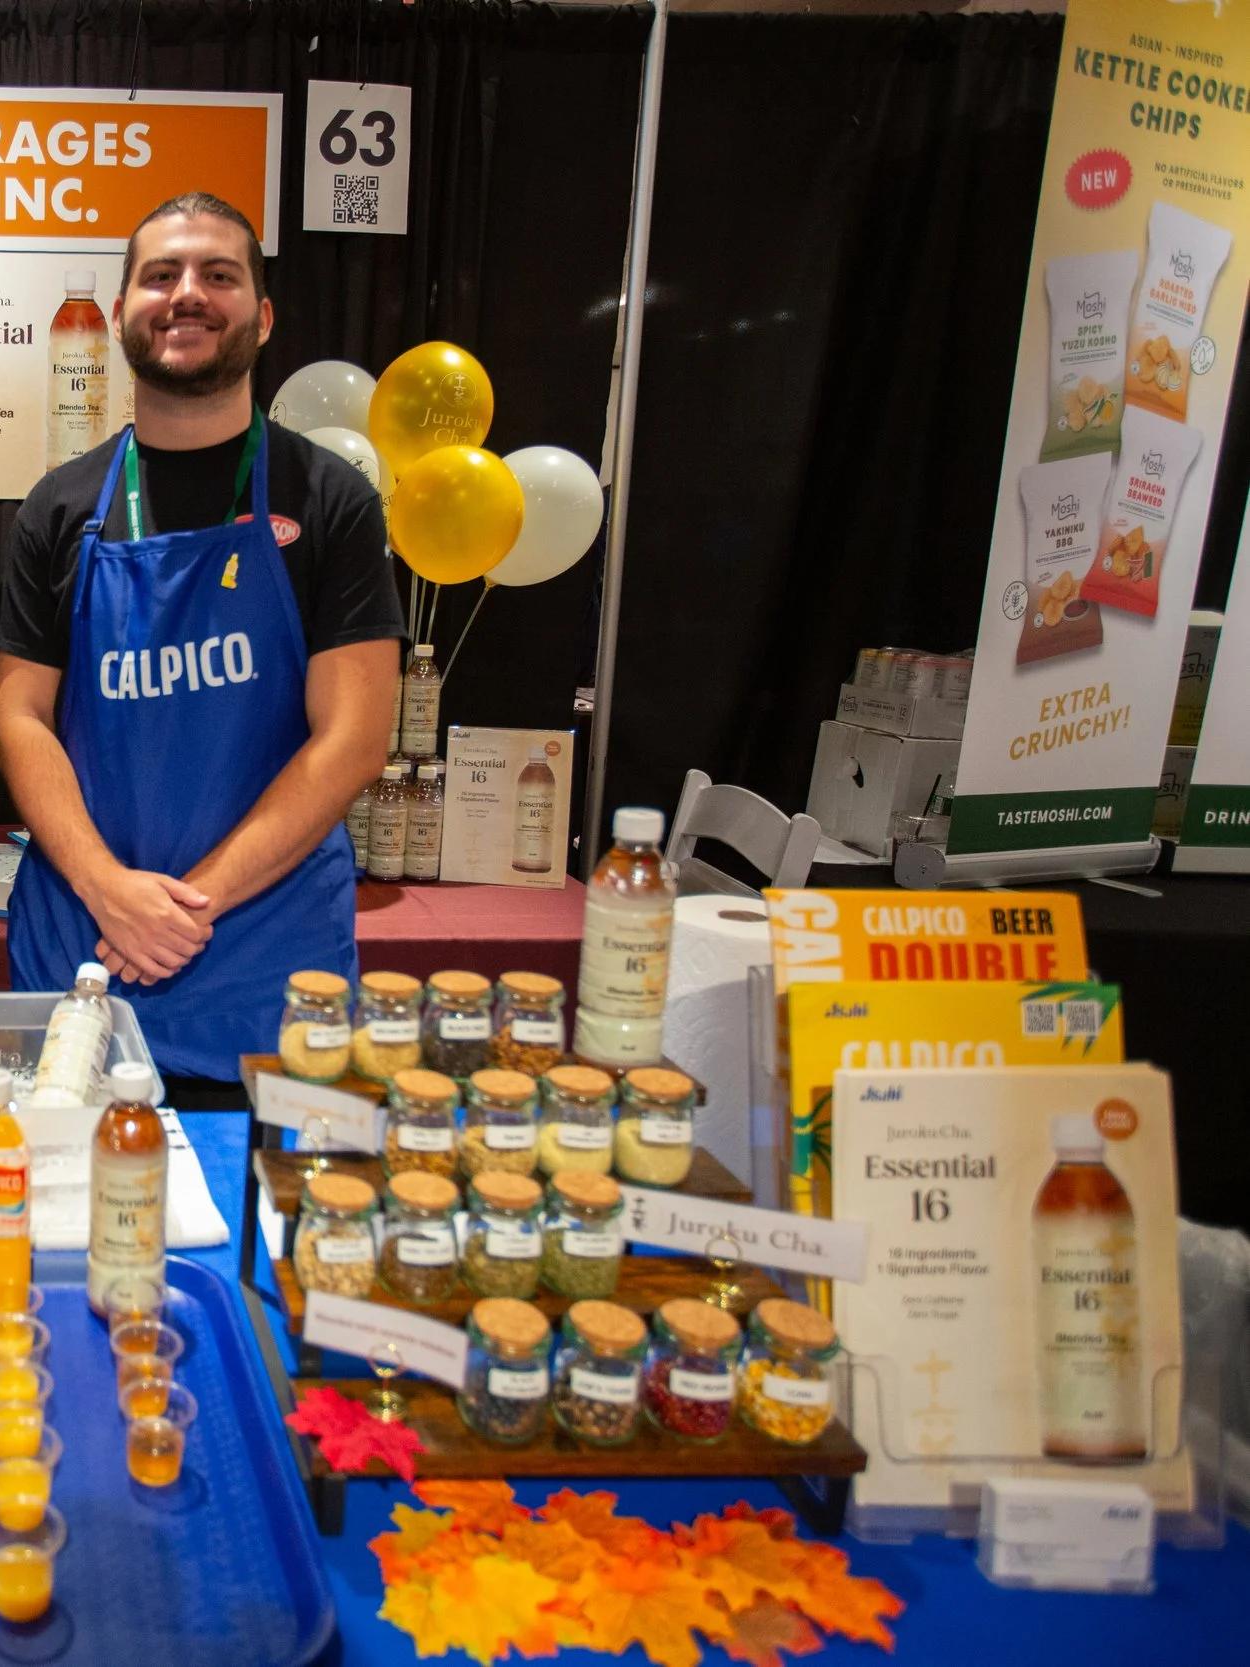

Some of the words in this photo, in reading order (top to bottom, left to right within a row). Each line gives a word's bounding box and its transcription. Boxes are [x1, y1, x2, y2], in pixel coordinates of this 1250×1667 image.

[1130, 34, 1162, 53] ASIAN
[1175, 46, 1223, 68] INSPIRED
[1074, 47, 1161, 92] KETTLE
[1130, 102, 1201, 139] CHIPS
[319, 109, 396, 167] 63
[1081, 168, 1117, 192] NEW
[1155, 162, 1167, 173] NO
[1169, 164, 1209, 182] ARTIFICIAL
[1210, 176, 1245, 190] FLAVORS
[1163, 177, 1174, 187] OR
[1175, 180, 1232, 200] PRESERVATIVES
[1170, 252, 1195, 279] Moshi
[1159, 279, 1194, 300] ROASTED
[1076, 295, 1106, 317] Moshi
[1077, 325, 1103, 336] SPICY
[1061, 339, 1085, 351] YUZU
[1088, 335, 1117, 348] KOSHO
[53, 364, 104, 375] Essential
[70, 378, 86, 391] 16
[59, 403, 86, 411] Blended
[420, 408, 482, 429] Juroku
[1141, 453, 1165, 478] Moshi
[1129, 477, 1165, 496] SRIRACHA
[1127, 489, 1162, 507] SEAWEED
[1051, 498, 1080, 519] Moshi
[1045, 522, 1085, 539] YAKINIKU
[1056, 537, 1073, 549] BBQ
[100, 632, 259, 700] CALPICO.
[416, 705, 426, 713] 16
[1039, 682, 1112, 723] EXTRA
[1009, 705, 1131, 761] CRUNCHY!
[454, 757, 506, 769] Essential
[470, 770, 487, 783] 16
[518, 801, 553, 809] Essential
[530, 810, 541, 818] 16
[358, 821, 368, 829] 16
[997, 806, 1113, 827] TASTEMOSHI.COM
[1204, 810, 1250, 826] DRIN
[383, 828, 393, 836] 16
[417, 828, 427, 836] 16
[862, 906, 967, 937] CALPICO
[990, 907, 1053, 936] BEER
[602, 936, 666, 953] Essential
[625, 956, 647, 974] 16
[825, 1002, 868, 1018] Asahi
[860, 1085, 903, 1101] Asahi
[864, 1153, 998, 1180] Essential
[910, 1188, 952, 1223] 16
[667, 1211, 758, 1245] Juroku
[1041, 1266, 1131, 1286] Essential
[1073, 1289, 1100, 1312] 16
